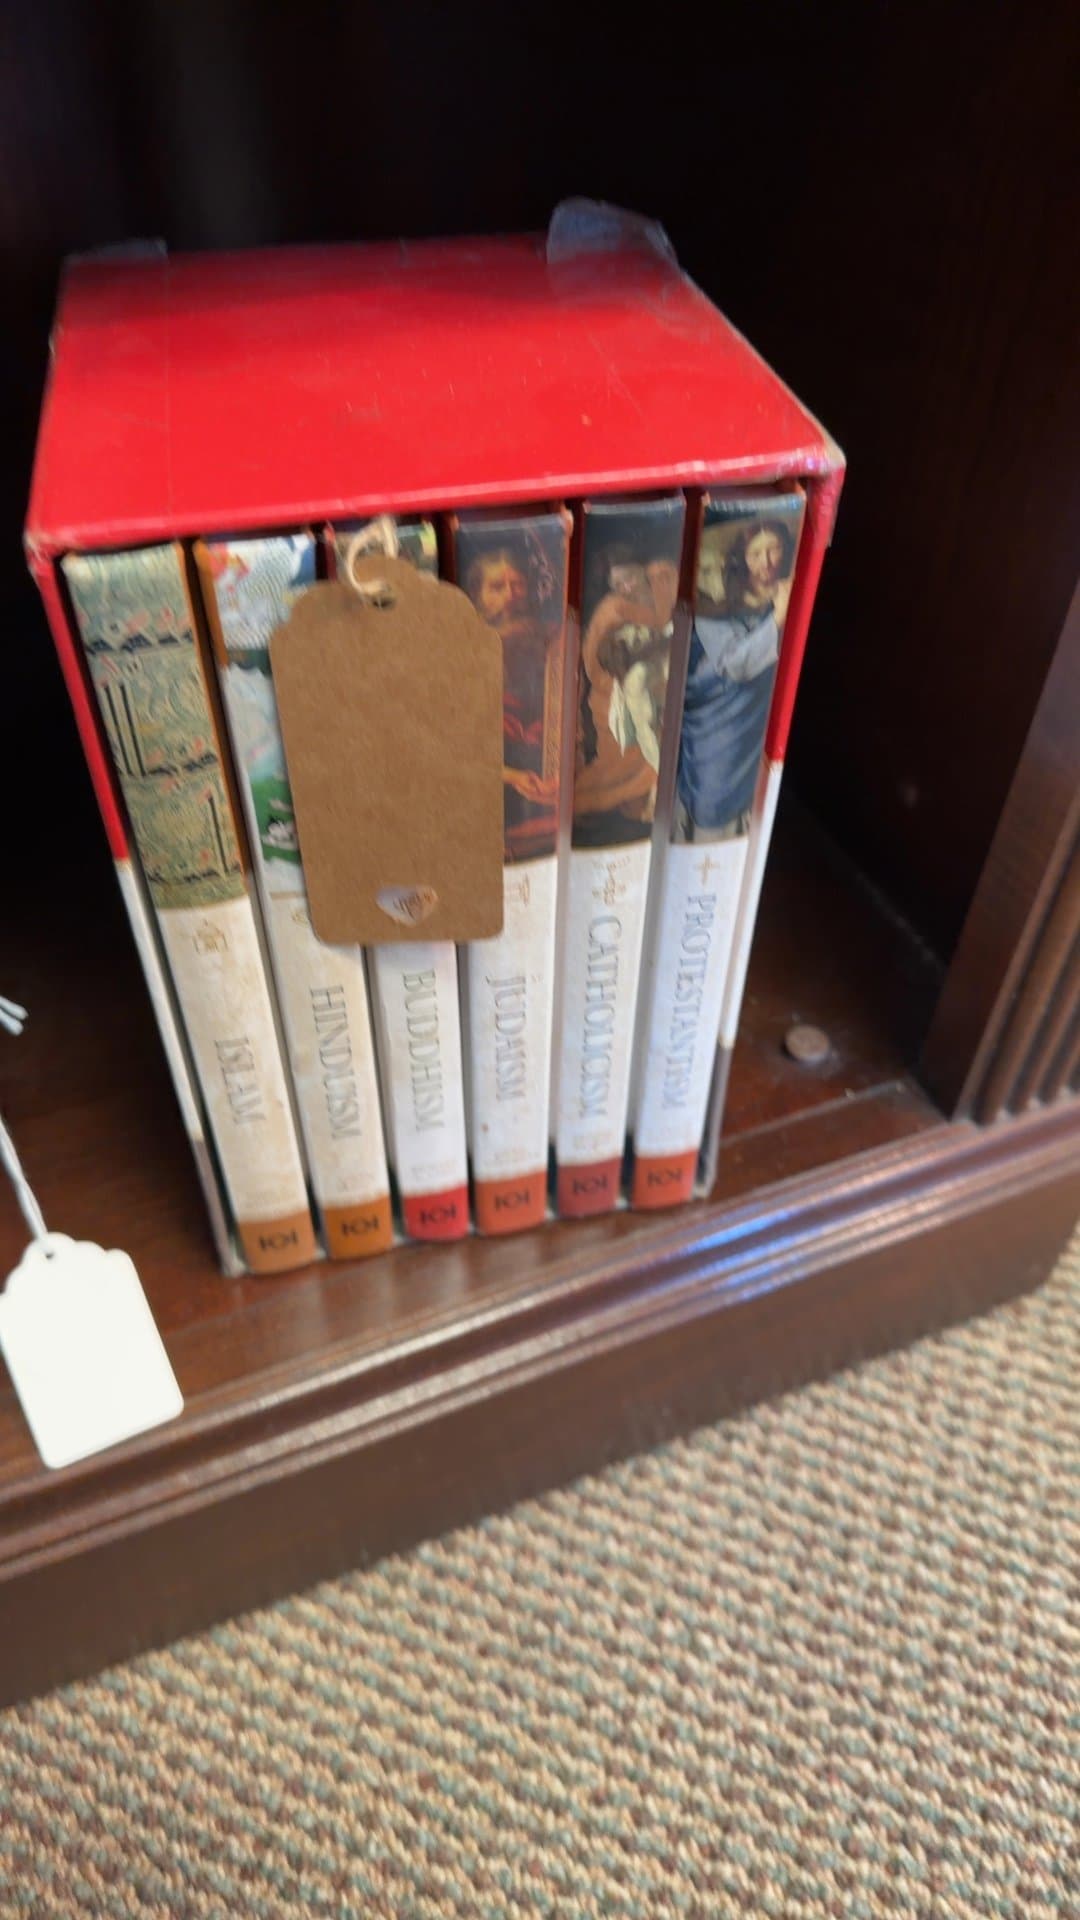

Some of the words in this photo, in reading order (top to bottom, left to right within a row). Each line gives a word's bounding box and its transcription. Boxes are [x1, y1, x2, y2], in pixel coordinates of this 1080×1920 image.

[214, 1037, 265, 1125] ISLAM
[311, 986, 361, 1139] HINDUISM
[404, 969, 444, 1132] BUDDHISM
[485, 975, 528, 1102] JUDAISM
[579, 915, 621, 1118] CATHOLICISM
